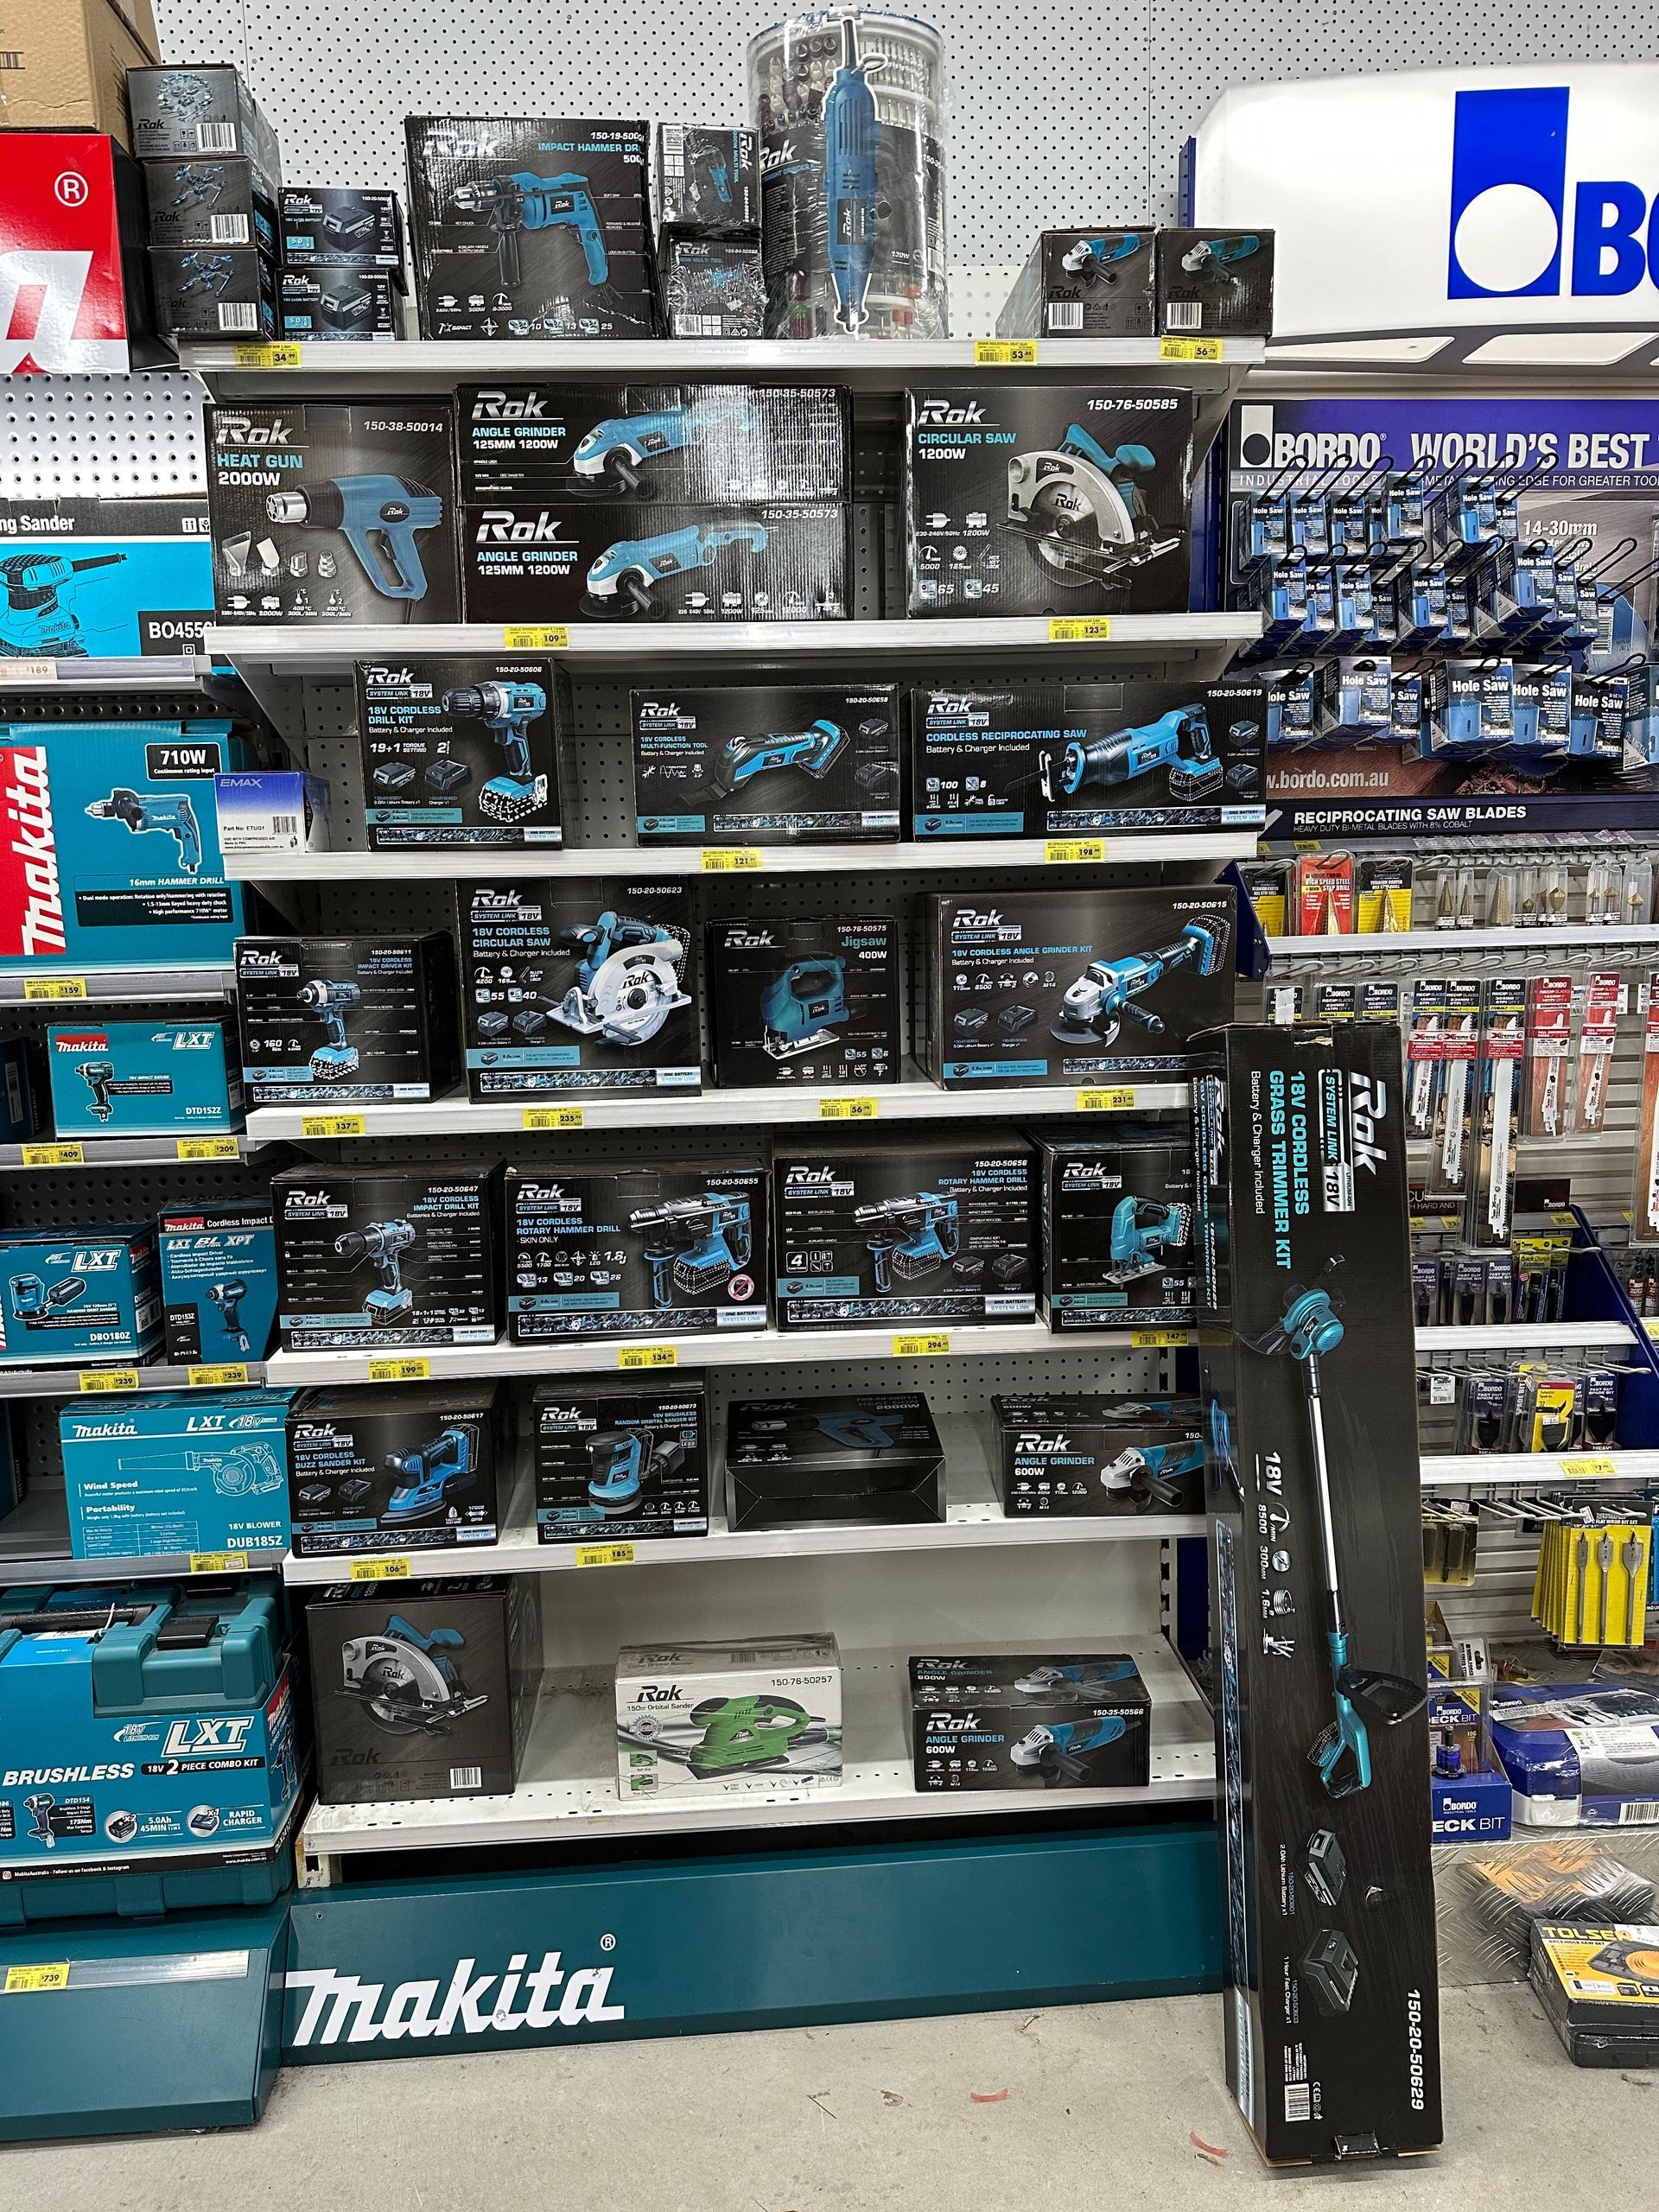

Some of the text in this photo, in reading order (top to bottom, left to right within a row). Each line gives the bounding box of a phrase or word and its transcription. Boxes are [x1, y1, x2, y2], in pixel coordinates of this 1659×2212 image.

[473, 391, 548, 418] Rok
[1087, 399, 1178, 410] 150-76-50585
[919, 400, 987, 424] Rok
[218, 417, 294, 444] Rok
[365, 421, 442, 431] 150-38-50014
[473, 427, 565, 437] ANGLE GRINDER
[474, 440, 558, 449] 125MM 1200W
[918, 433, 1016, 443] CIRCULAR SAW
[918, 448, 966, 460] 1200W
[1567, 432, 1649, 469] BEST
[218, 454, 302, 468] HEAT GUN
[219, 472, 280, 486] 2000W
[1518, 476, 1630, 486] EDGE FOR GREATER
[761, 509, 838, 519] 150-35-50573
[21, 516, 74, 531] Sander
[477, 512, 563, 541] Rok
[1524, 520, 1597, 536] 14-30mm
[477, 551, 577, 562] ANGLE GRINDER
[479, 564, 570, 575] 125MM 1200W
[149, 621, 216, 639] BO455
[26, 666, 48, 675] $189
[368, 668, 414, 684] Rok
[1207, 689, 1262, 697] 150-20-50619
[1453, 679, 1509, 693] Hole Saw
[1541, 685, 1567, 697] Saw
[640, 702, 681, 716] Rok
[927, 697, 972, 713] Rok
[1575, 695, 1623, 709] Hole Saw
[400, 726, 425, 734] Charger
[926, 729, 1087, 742] CORDLESS RECIPROCATING SAW
[926, 743, 1029, 754] Battery Charger Included
[160, 750, 206, 765] 710W
[220, 779, 263, 788] EMAX
[1294, 806, 1527, 823] RECIPROCATING SAW BLADES
[1294, 824, 1318, 833] HEAVY
[1342, 823, 1376, 831] BI-METAL
[1429, 821, 1441, 830] 8%
[1443, 820, 1472, 829] COBALT
[6, 753, 66, 956] makita
[130, 878, 156, 887] 16mm
[472, 890, 522, 906] Rok
[953, 910, 1004, 926] Rok
[496, 927, 550, 936] CORDLESS
[725, 930, 775, 947] Rok
[473, 938, 524, 947] CIRCULAR
[842, 936, 887, 949] Jigsaw
[241, 951, 283, 964] Rok
[56, 1040, 109, 1052] makita
[173, 1033, 214, 1050] LXT
[1325, 1077, 1338, 1160] SYSTEM LINK
[1291, 1071, 1309, 1215] 18V CORDLESS
[786, 1166, 836, 1182] Rok
[1269, 1071, 1291, 1268] GRASS TRIMMER KIT
[286, 1192, 331, 1206] Rok
[71, 1249, 122, 1272] LXT
[90, 1332, 130, 1343] DBO180Z
[73, 1415, 226, 1438] makita LXT
[295, 1424, 337, 1438] Rok
[1014, 1457, 1095, 1465] ANGLE GRINDER
[109, 1481, 138, 1491] Speed
[86, 1504, 135, 1515] Portability
[246, 1521, 281, 1529] BLOWER
[1258, 1504, 1267, 1535] 8500
[227, 1535, 283, 1548] DUB185Z
[771, 1676, 832, 1686] 150-76-50257
[162, 1716, 255, 1758] LXT
[926, 1735, 957, 1744] ANGLE
[167, 1759, 258, 1776] 2 PIECE COMBO KIT
[3, 1764, 134, 1787] BRUSHLESS
[229, 1810, 255, 1819] RAPID
[223, 1817, 263, 1827] CHARGER
[1433, 1817, 1505, 1833] ECK BIT
[41, 1973, 60, 1983] $739
[286, 1952, 625, 2046] makita
[1408, 1989, 1424, 2110] 150-20-50629
